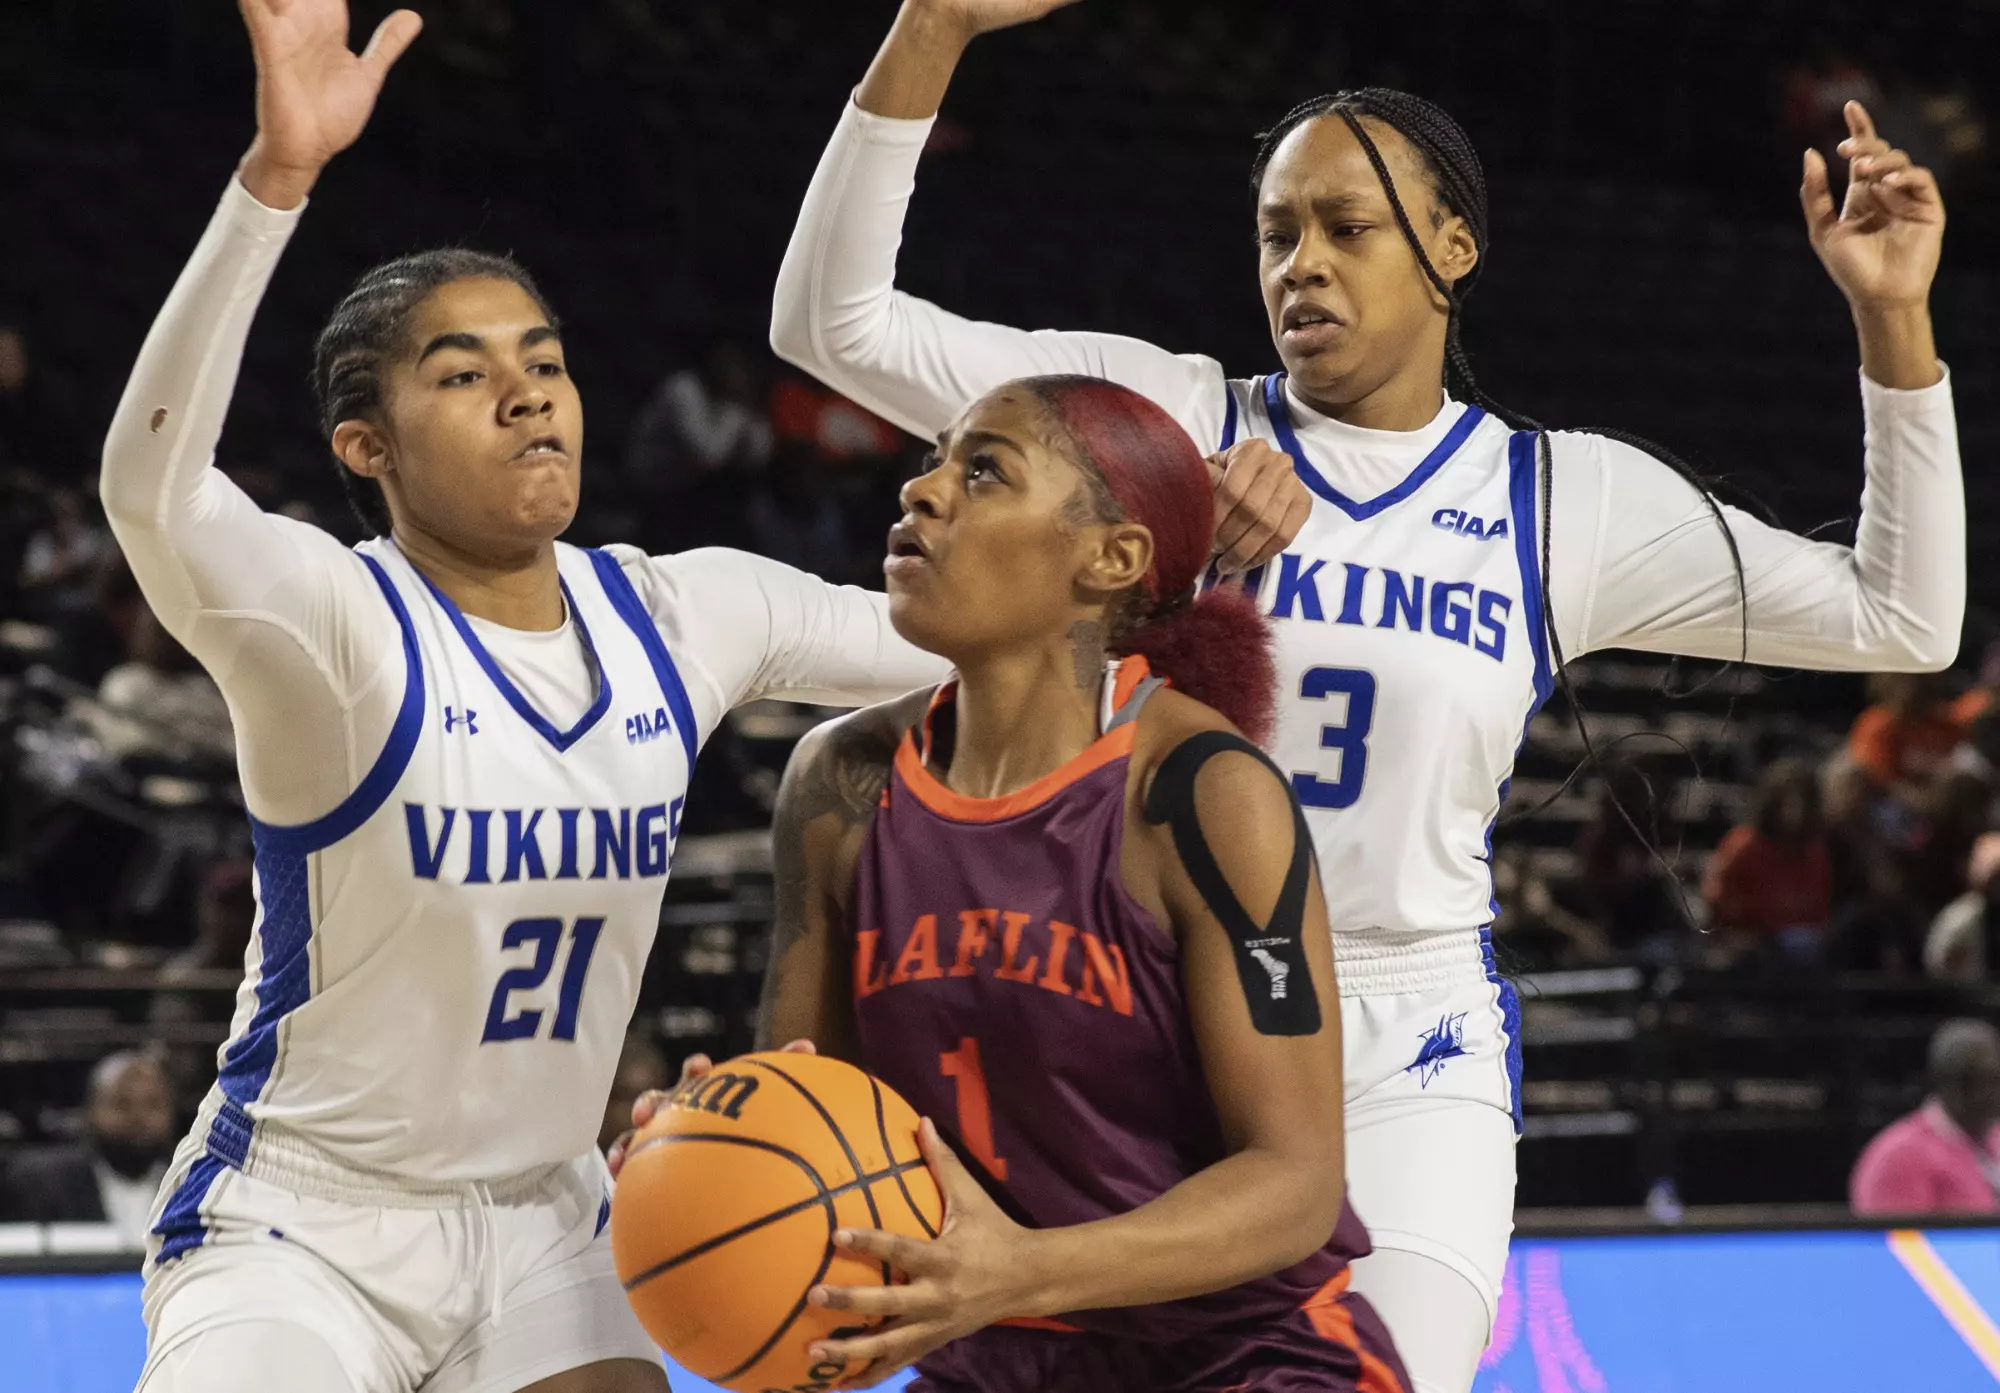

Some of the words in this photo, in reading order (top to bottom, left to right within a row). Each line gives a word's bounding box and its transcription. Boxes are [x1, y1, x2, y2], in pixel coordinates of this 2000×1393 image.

[1431, 508, 1509, 541] CIAA
[626, 707, 672, 745] CIAA
[1289, 664, 1378, 811] 3
[479, 914, 607, 1046] 21
[939, 1036, 1007, 1181] 1
